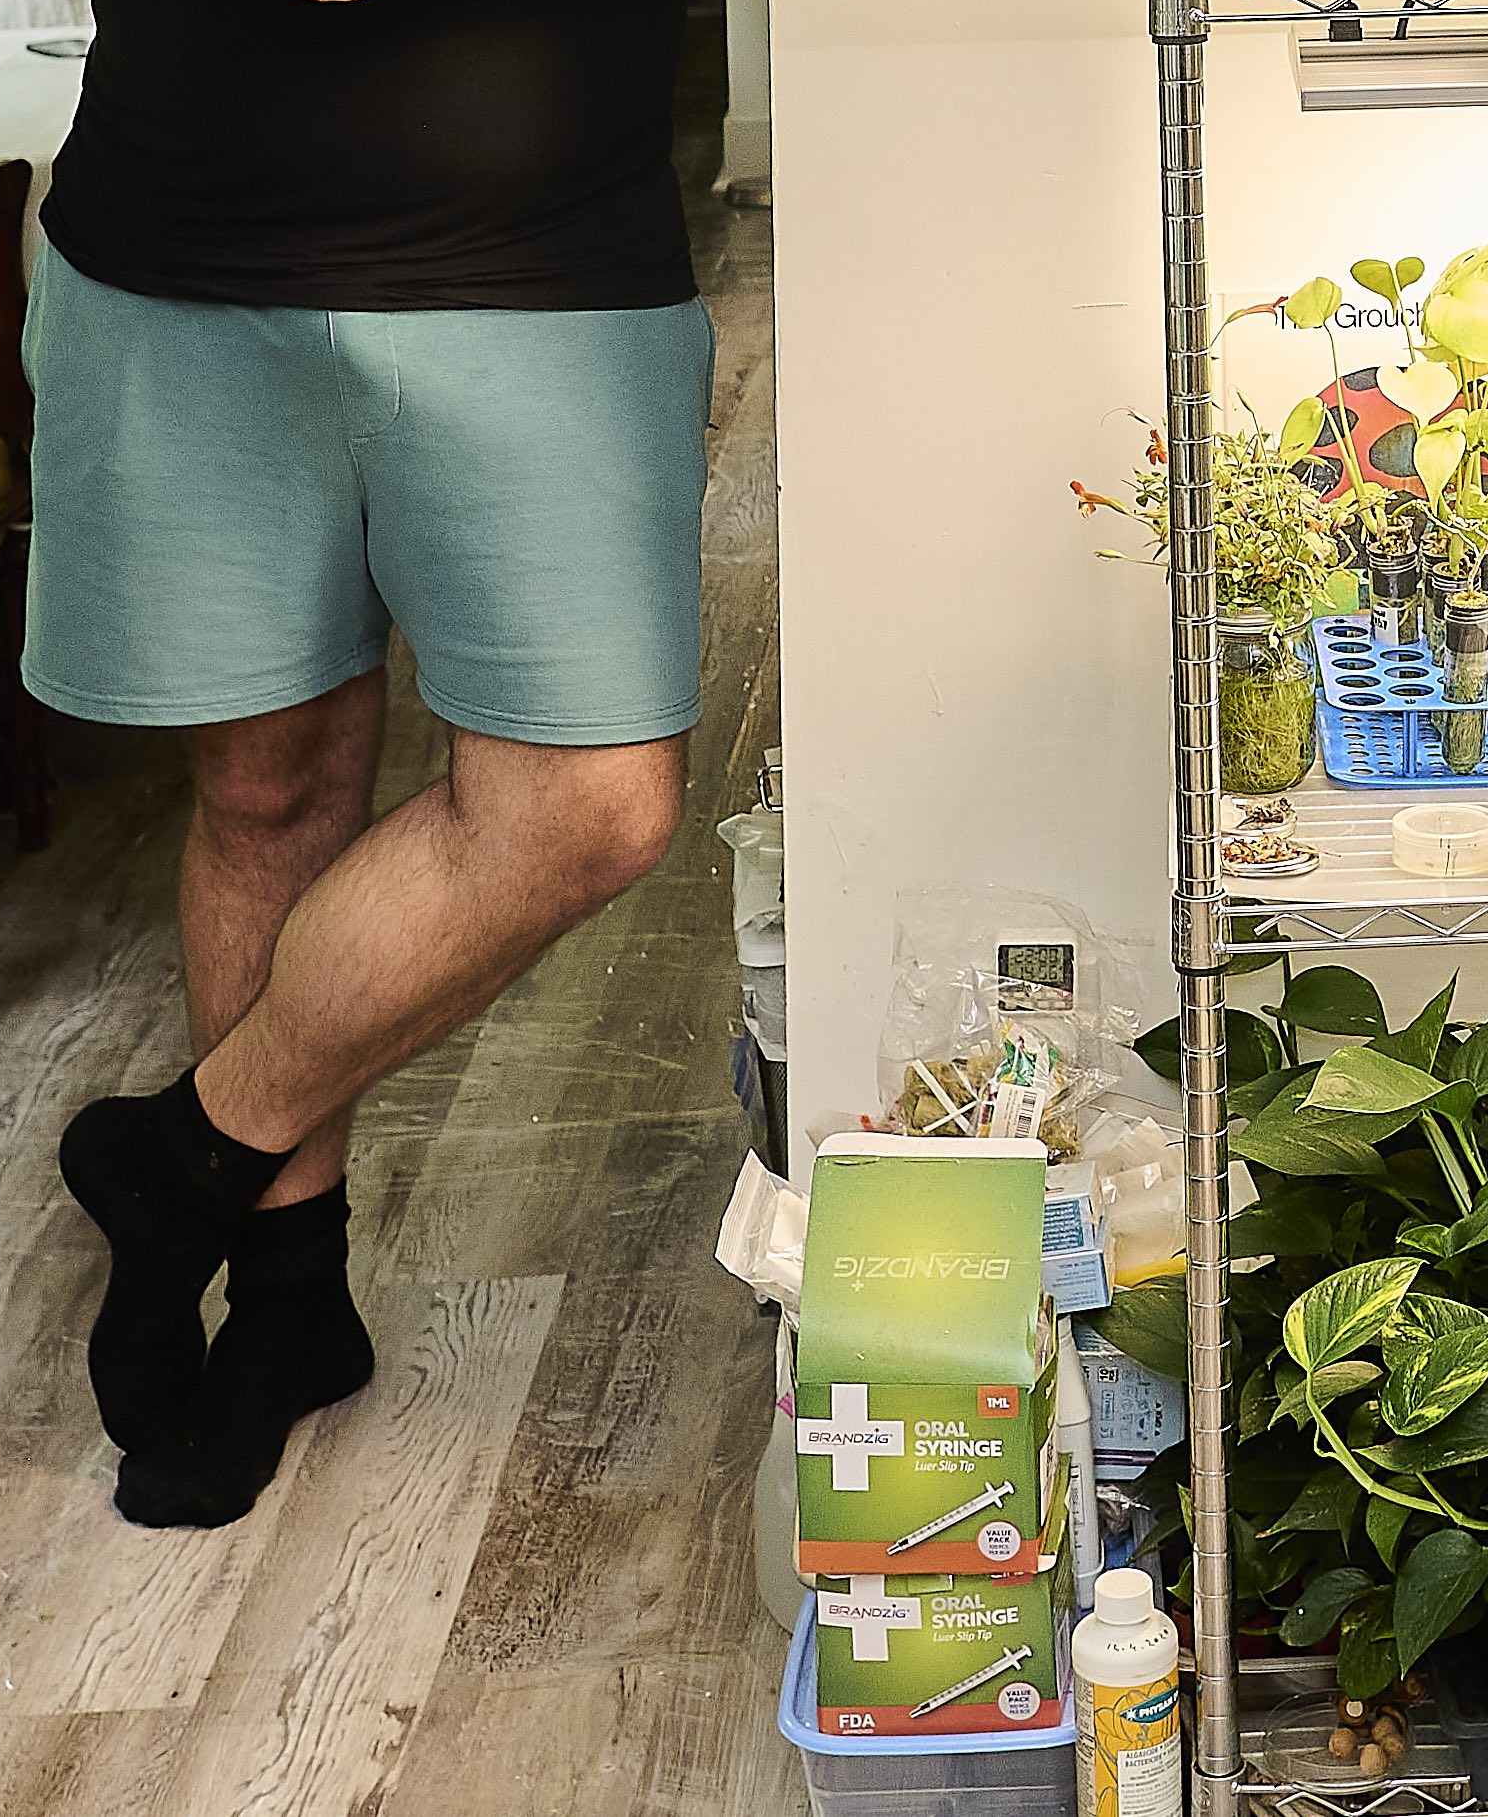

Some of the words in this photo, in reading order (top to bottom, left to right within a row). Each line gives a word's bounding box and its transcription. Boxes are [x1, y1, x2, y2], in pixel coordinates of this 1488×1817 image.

[986, 1397, 1011, 1409] 1ML
[914, 1421, 969, 1437] ORAL
[915, 1440, 1003, 1457] SYRINGE
[915, 1460, 936, 1471] Luer
[938, 1460, 958, 1472] Slip
[959, 1461, 975, 1473] Tip
[931, 1594, 985, 1611] ORAL
[931, 1607, 1019, 1629] SYRINGE
[933, 1632, 954, 1642] Luer
[956, 1631, 975, 1642] Slip
[977, 1629, 993, 1642] Tip
[839, 1713, 875, 1729] FDA
